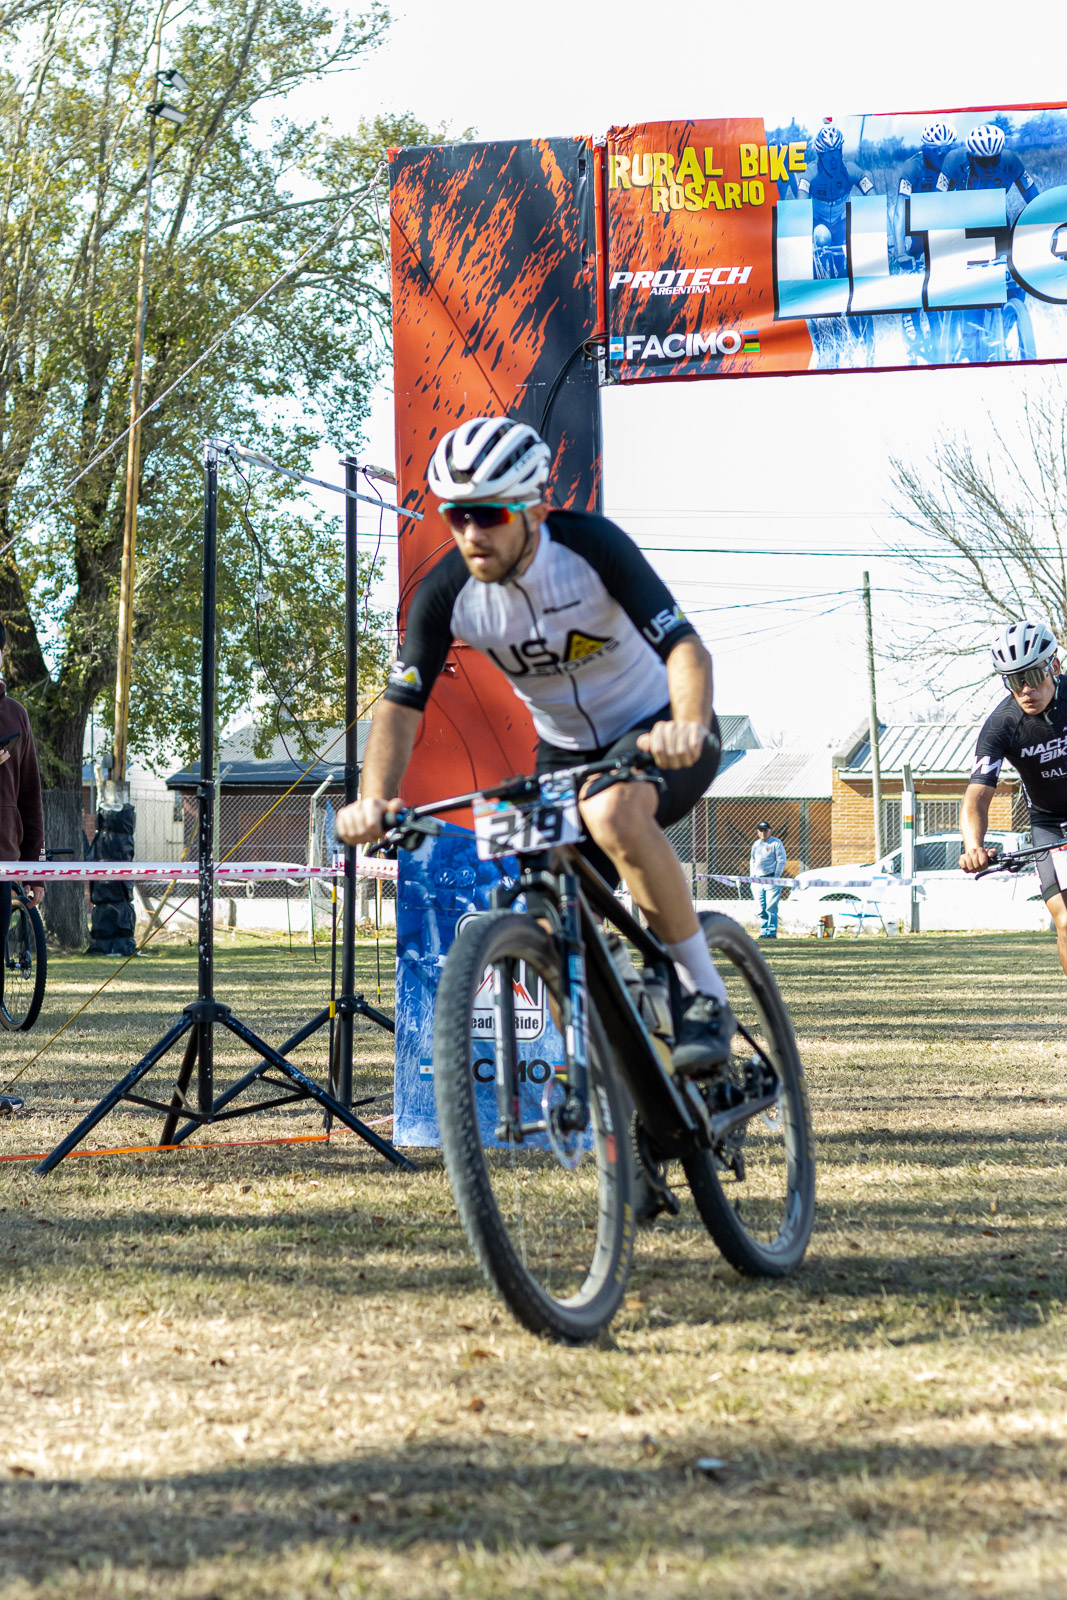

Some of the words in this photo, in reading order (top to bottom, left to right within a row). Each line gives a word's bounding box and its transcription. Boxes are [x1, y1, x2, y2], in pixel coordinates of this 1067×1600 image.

[608, 146, 724, 188] RURAL
[740, 141, 807, 182] BIKE
[652, 180, 765, 212] ROSARIO
[609, 265, 753, 290] PROTECH
[649, 285, 711, 296] ARGENTINA
[625, 329, 742, 360] FACIMO
